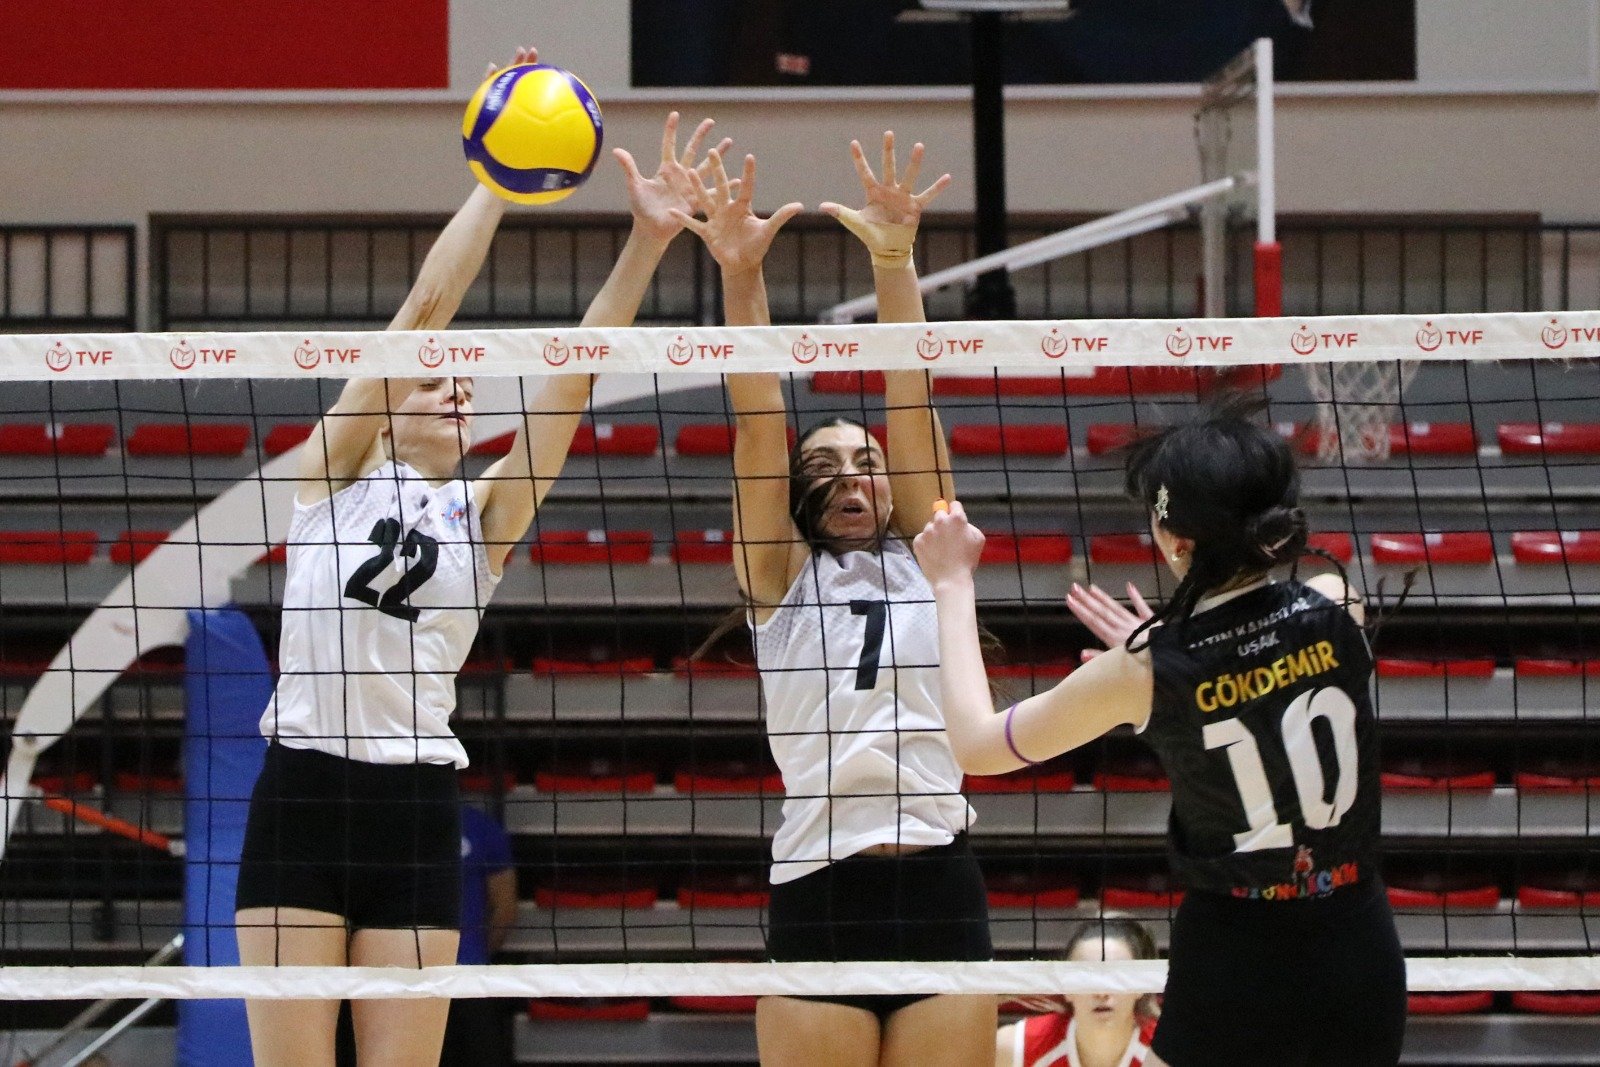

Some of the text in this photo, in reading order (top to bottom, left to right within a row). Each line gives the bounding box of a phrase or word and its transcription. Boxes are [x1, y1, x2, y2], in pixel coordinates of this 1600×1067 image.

[1071, 337, 1108, 351] TVF
[1196, 336, 1233, 350] TVF
[1321, 333, 1359, 348] TVF
[1446, 330, 1484, 345] TVF
[572, 345, 610, 360] TVF
[697, 344, 734, 359] TVF
[822, 342, 859, 357] TVF
[946, 339, 984, 353] TVF
[76, 351, 113, 366] TVF
[200, 349, 237, 363] TVF
[324, 348, 361, 363] TVF
[448, 347, 485, 362] TVF
[344, 517, 440, 623] 22
[849, 599, 888, 691] 7
[1237, 630, 1281, 657] UŞAK
[1194, 640, 1340, 713] GÖKDEMİR
[1201, 686, 1359, 853] 10
